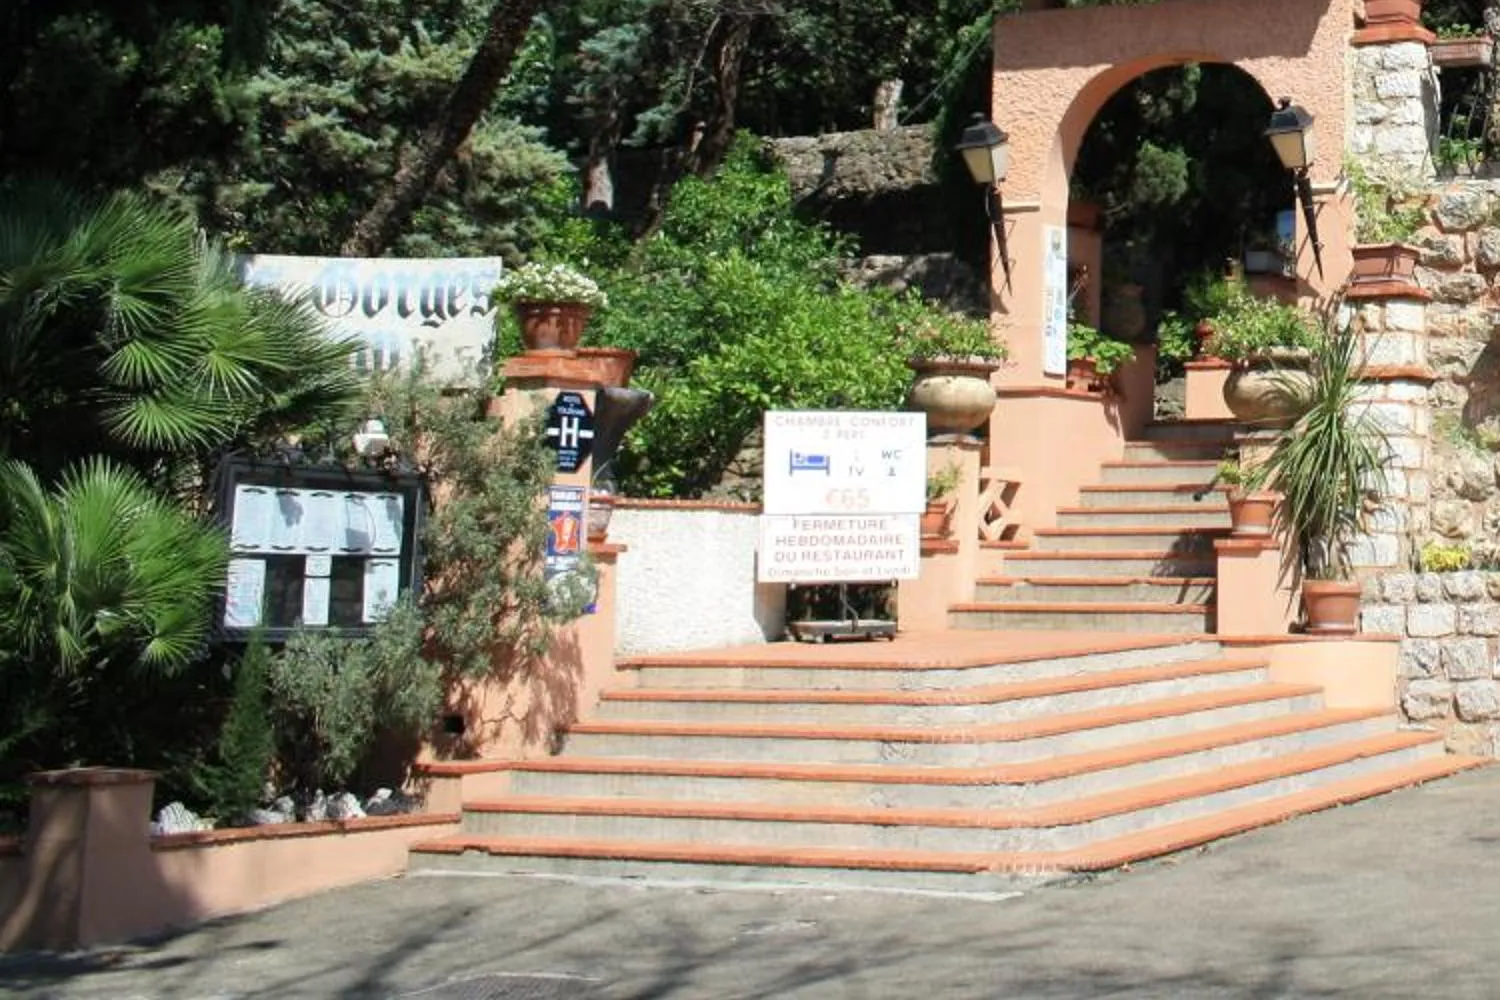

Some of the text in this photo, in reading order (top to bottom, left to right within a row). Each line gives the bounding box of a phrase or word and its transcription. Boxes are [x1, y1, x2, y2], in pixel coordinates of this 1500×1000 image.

[312, 262, 497, 328] Gorges
[773, 415, 841, 428] CHAMBRE
[881, 449, 903, 461] WC
[792, 519, 888, 531] FERMETURE
[775, 534, 905, 547] HEBDOMADAIRE
[774, 549, 905, 563] DU RESTAURANT
